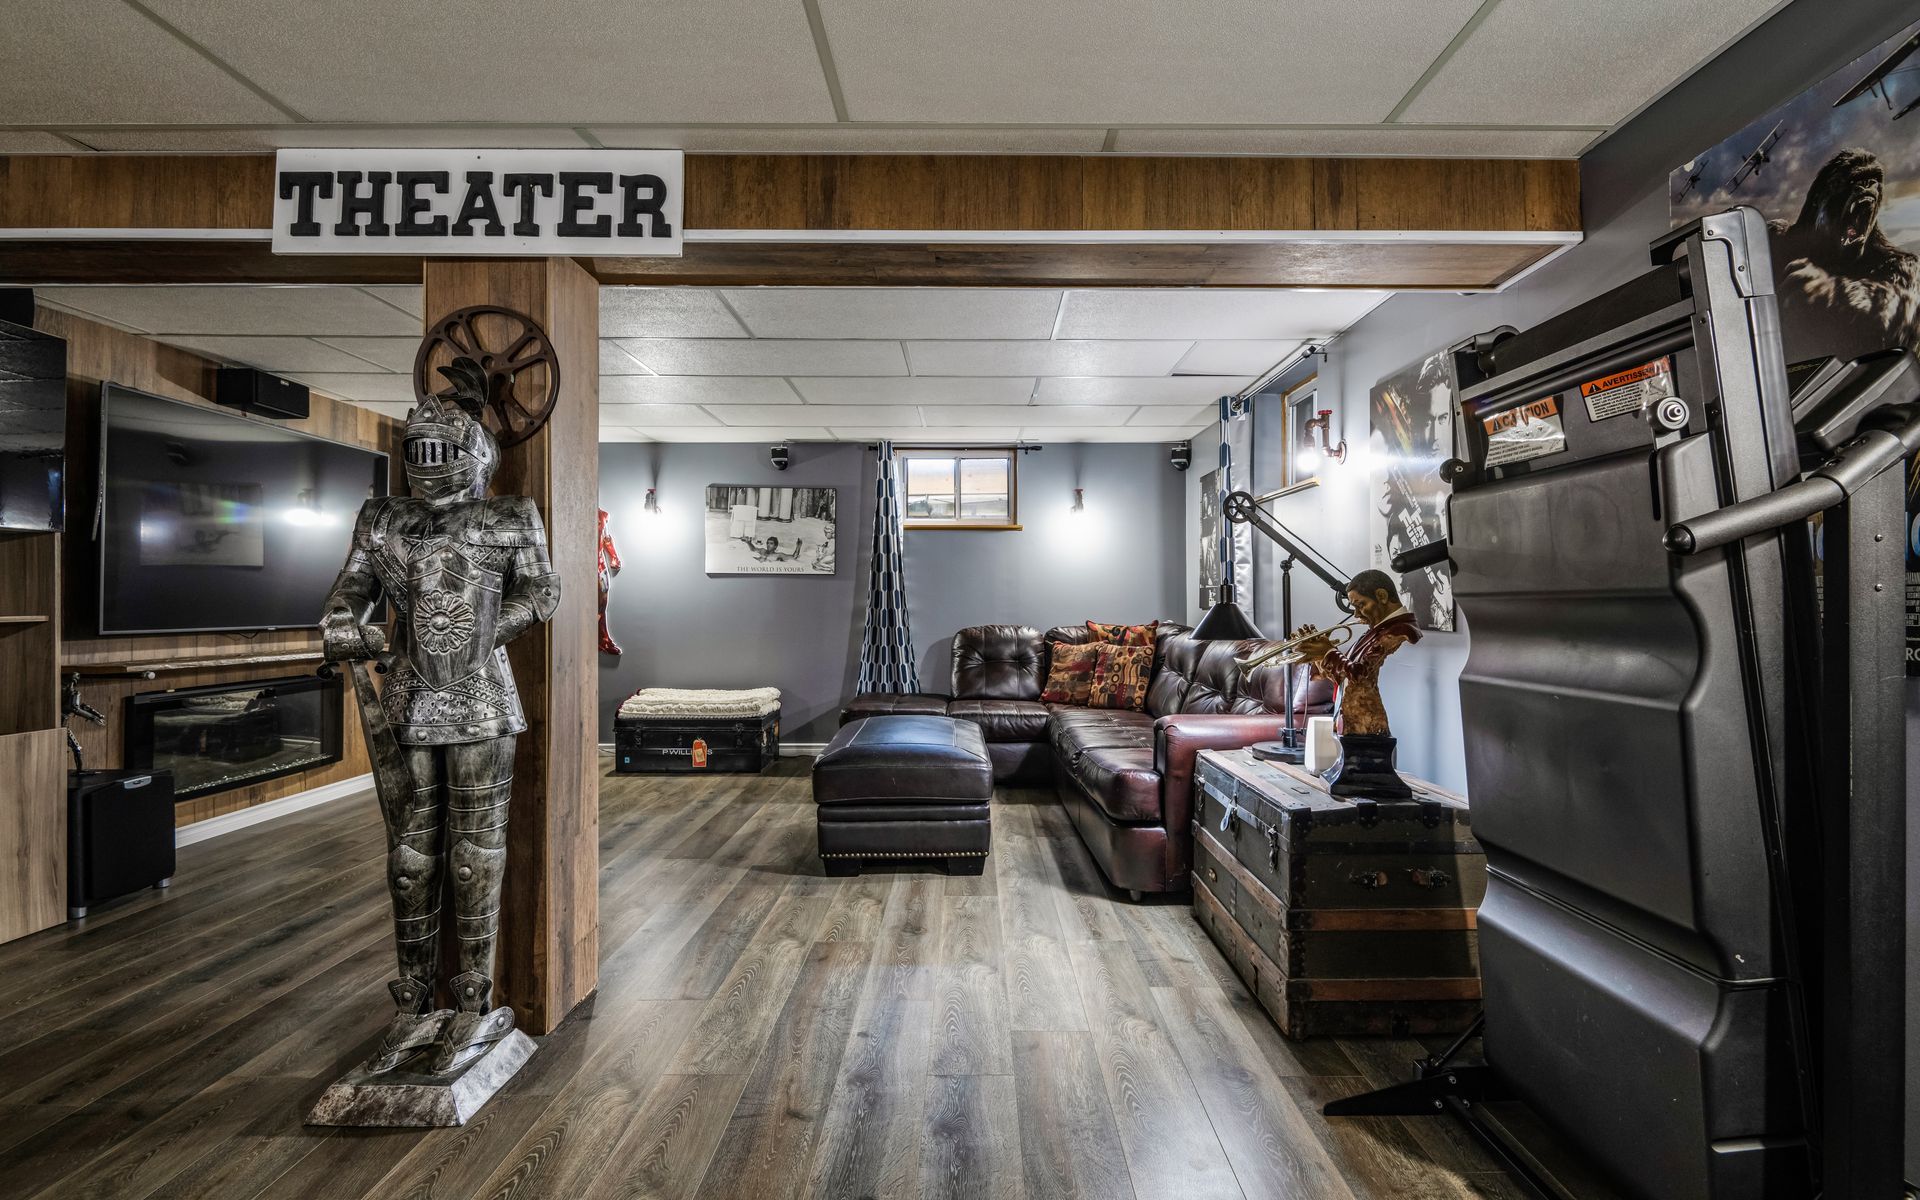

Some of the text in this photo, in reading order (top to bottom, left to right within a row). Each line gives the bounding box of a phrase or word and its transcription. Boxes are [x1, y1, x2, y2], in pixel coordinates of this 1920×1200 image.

[279, 171, 672, 238] THEATER
[1602, 363, 1661, 389] AVERTISSE
[1398, 508, 1437, 585] FURUS
[1410, 508, 1430, 546] FAS
